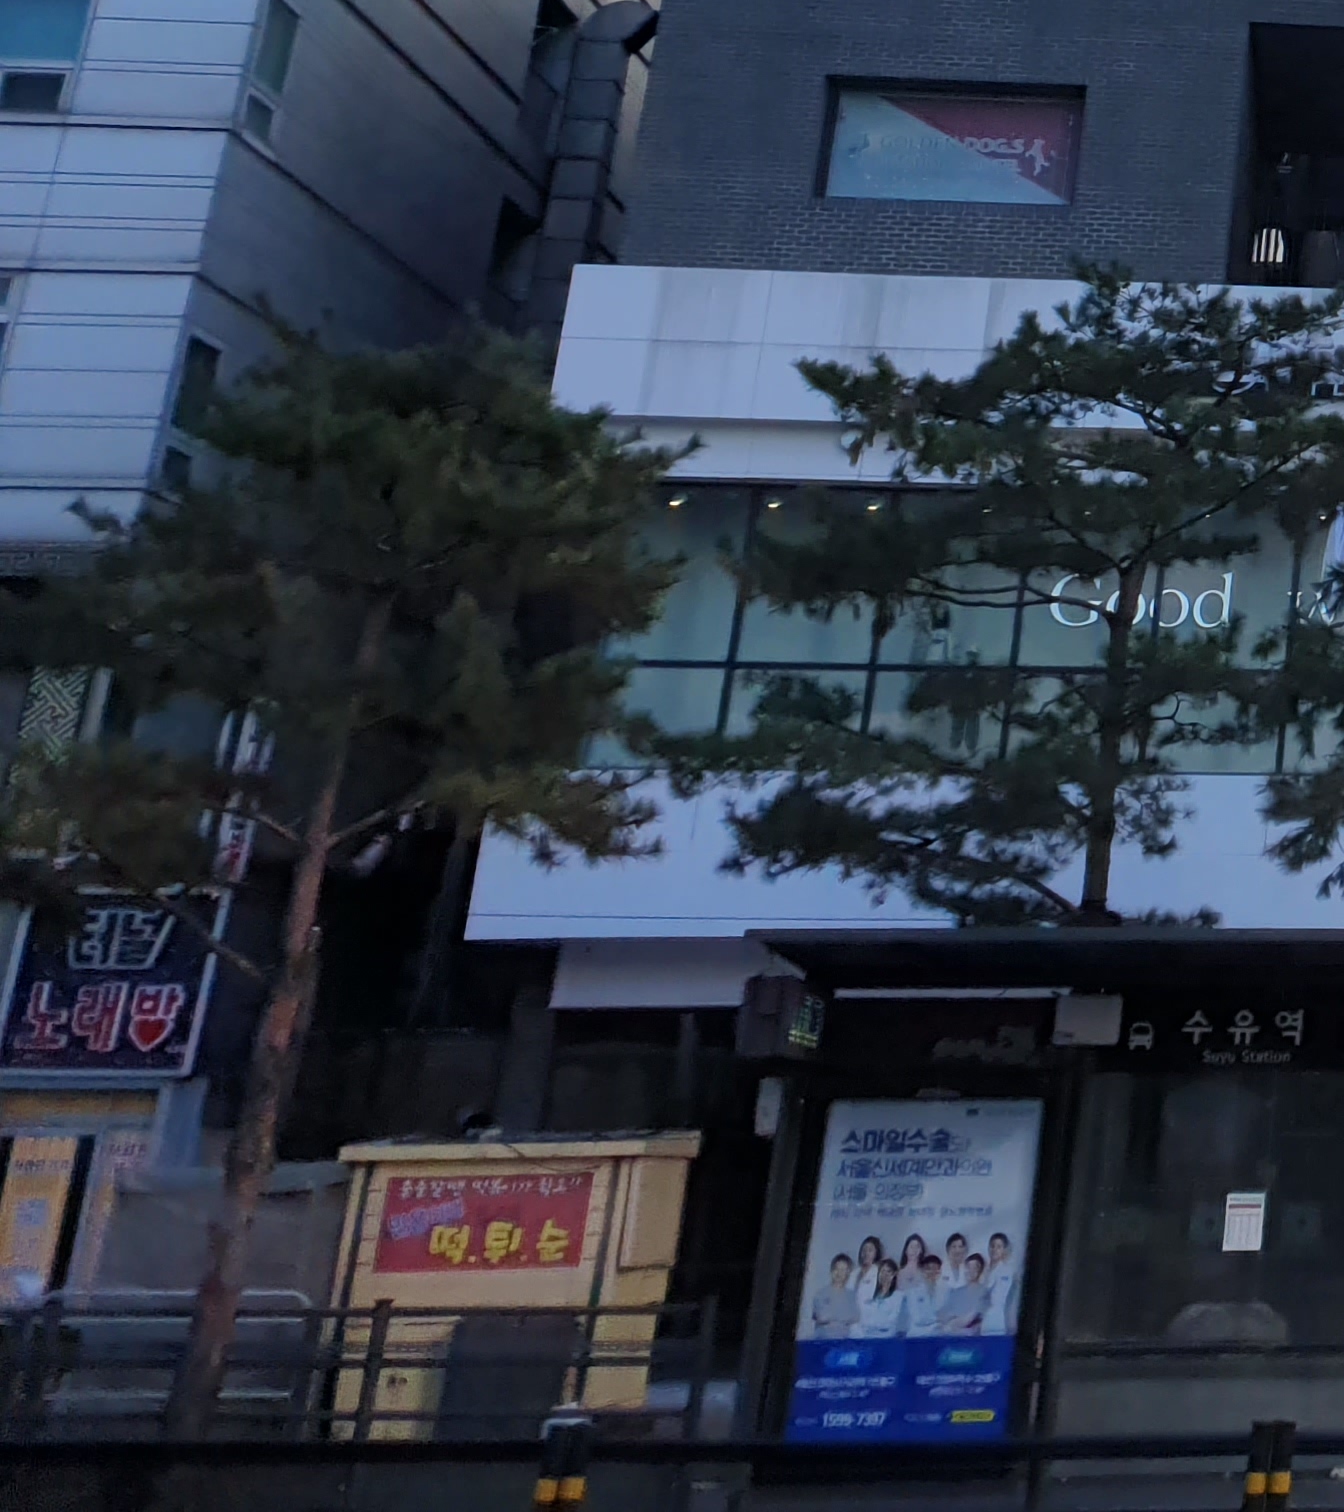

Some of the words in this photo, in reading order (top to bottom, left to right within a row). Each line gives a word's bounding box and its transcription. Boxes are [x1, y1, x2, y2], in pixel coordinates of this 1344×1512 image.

[964, 136, 1025, 154] DOGS
[1050, 571, 1234, 629] Good
[13, 980, 186, 1052] 노래방
[1181, 1008, 1305, 1046] 수유역
[1202, 1049, 1236, 1065] Suyu
[1241, 1049, 1292, 1064] Station
